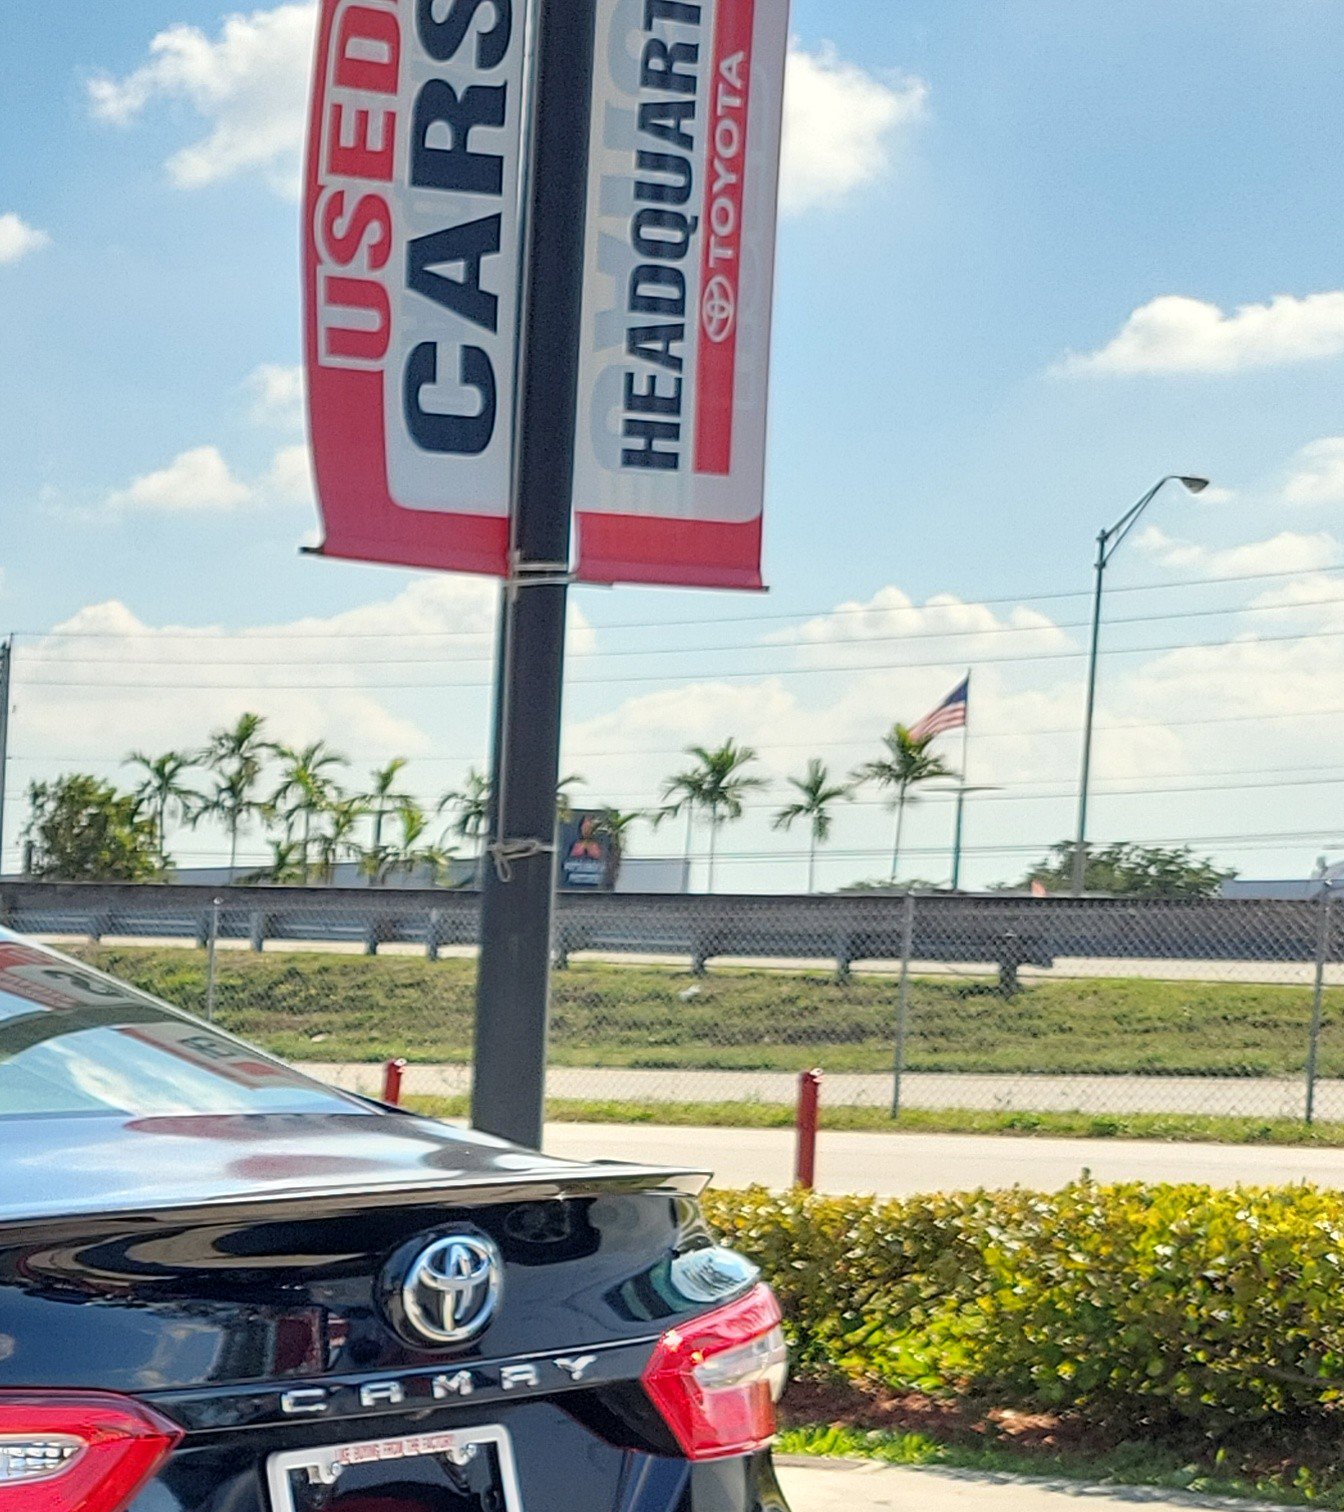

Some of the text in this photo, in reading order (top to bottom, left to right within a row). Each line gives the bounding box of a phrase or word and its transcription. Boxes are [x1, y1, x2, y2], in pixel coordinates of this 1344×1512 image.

[320, 1, 402, 364] USED
[402, 0, 512, 456] CARS
[710, 50, 747, 268] TOYOTA
[281, 1354, 598, 1414] CAMRY
